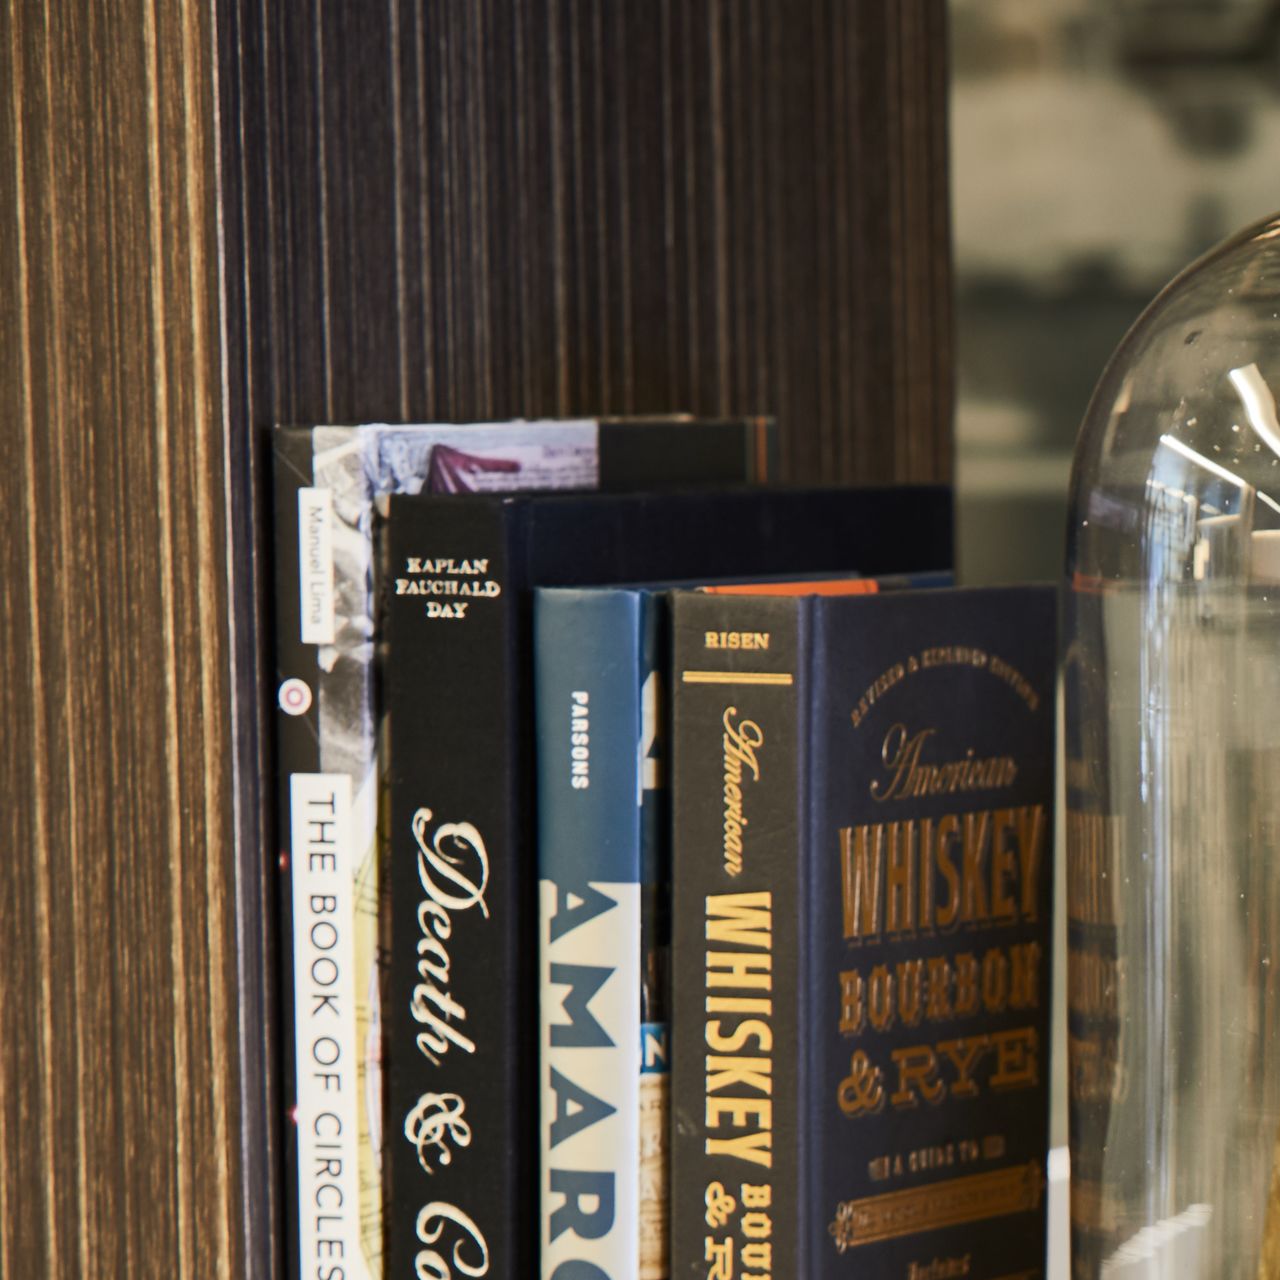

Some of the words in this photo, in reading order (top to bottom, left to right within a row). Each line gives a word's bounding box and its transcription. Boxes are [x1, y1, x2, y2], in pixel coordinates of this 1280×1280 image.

[308, 505, 326, 575] Manuel
[406, 557, 489, 575] KAPLAN
[309, 582, 325, 625] Lima
[395, 578, 501, 599] FAUCHALD
[426, 601, 468, 619] DAY
[704, 631, 770, 650] RISEN
[571, 690, 589, 790] PARSONS
[869, 722, 1018, 802] American
[308, 791, 337, 873] THE
[723, 706, 764, 877] American
[838, 804, 1045, 946] WHISKEY
[309, 894, 340, 1017] BOOK
[411, 806, 490, 1067] Death
[705, 890, 772, 1169] WHISKEY
[838, 941, 1041, 1037] BOURBON
[312, 1036, 342, 1094] OF
[837, 1048, 886, 1118] &
[890, 1026, 1039, 1110] RYE
[403, 1091, 472, 1175] &
[704, 1181, 736, 1228] &
